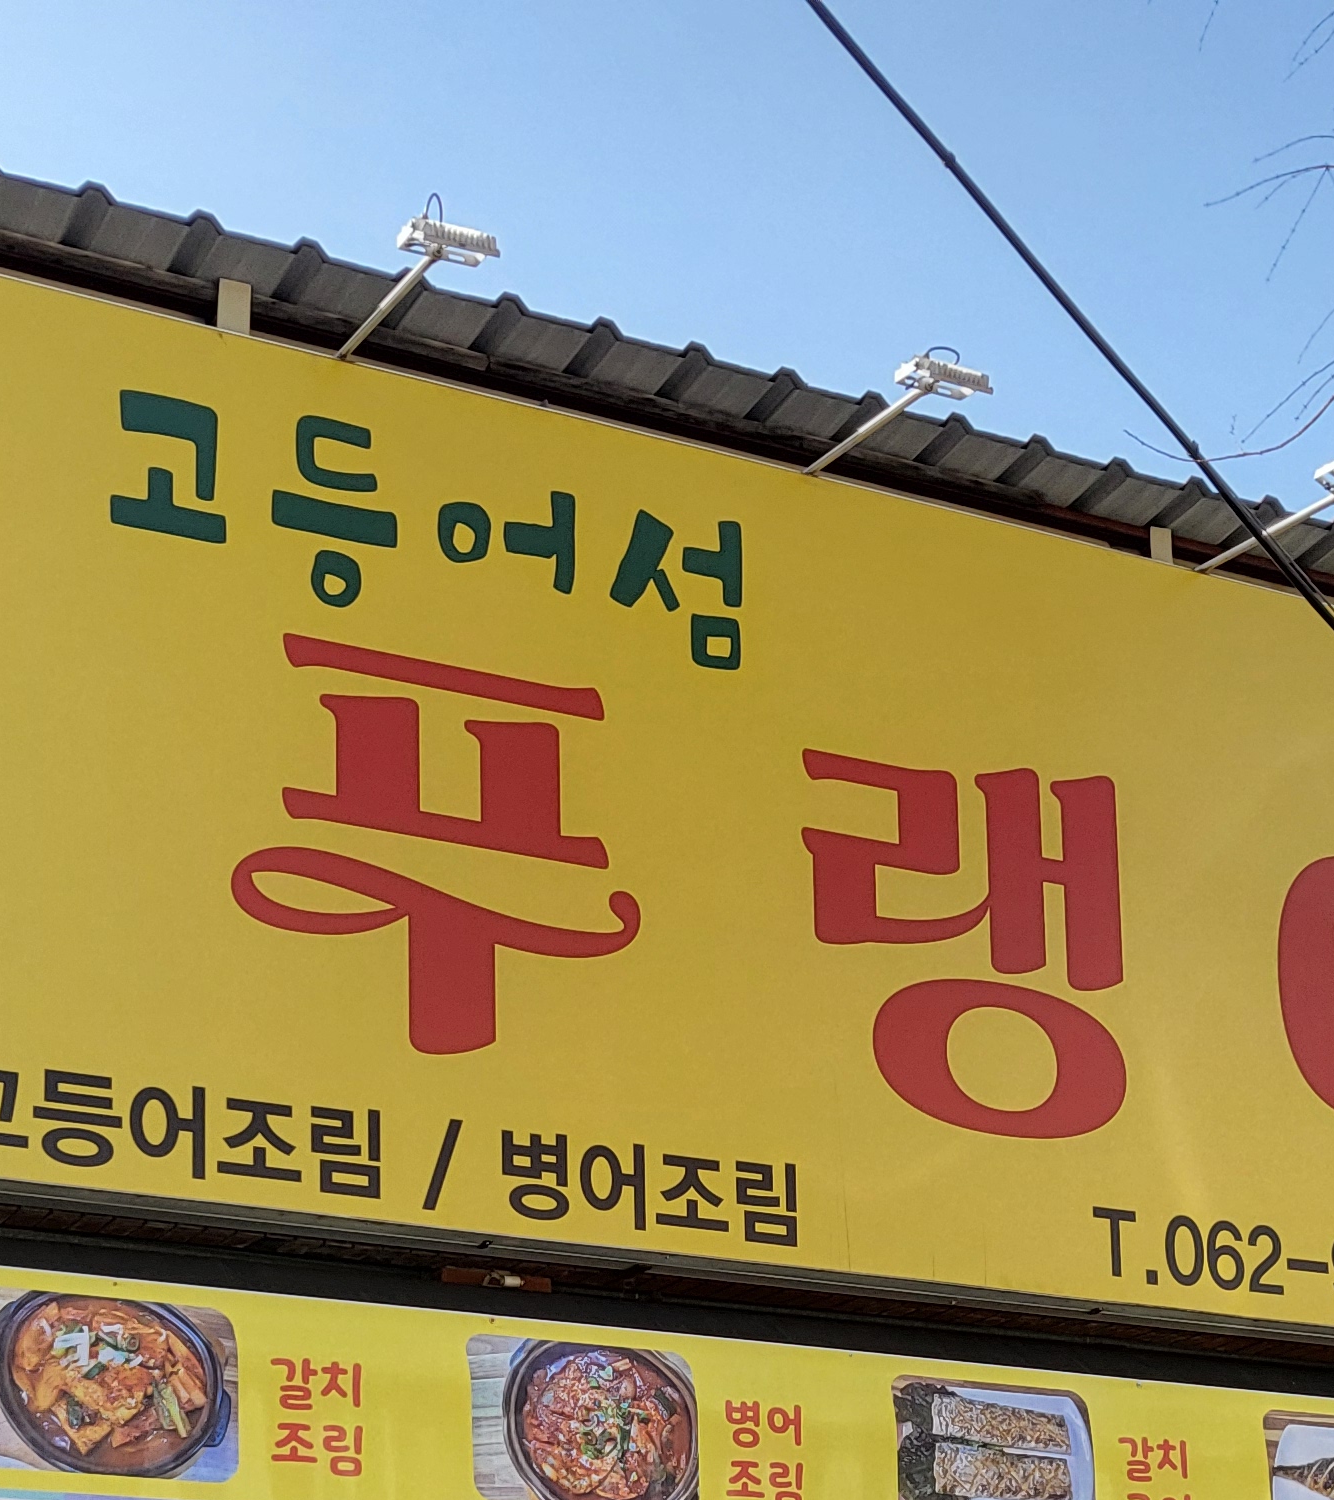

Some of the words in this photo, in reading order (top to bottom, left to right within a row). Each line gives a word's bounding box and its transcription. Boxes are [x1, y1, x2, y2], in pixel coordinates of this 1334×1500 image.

[111, 389, 743, 672] 고등어섬
[423, 1119, 463, 1211] /
[499, 1129, 801, 1248] 병어조림
[270, 1357, 363, 1412] 갈치
[271, 1421, 364, 1477] 조림
[724, 1400, 804, 1449] 병어
[1119, 1436, 1189, 1483] 갈치
